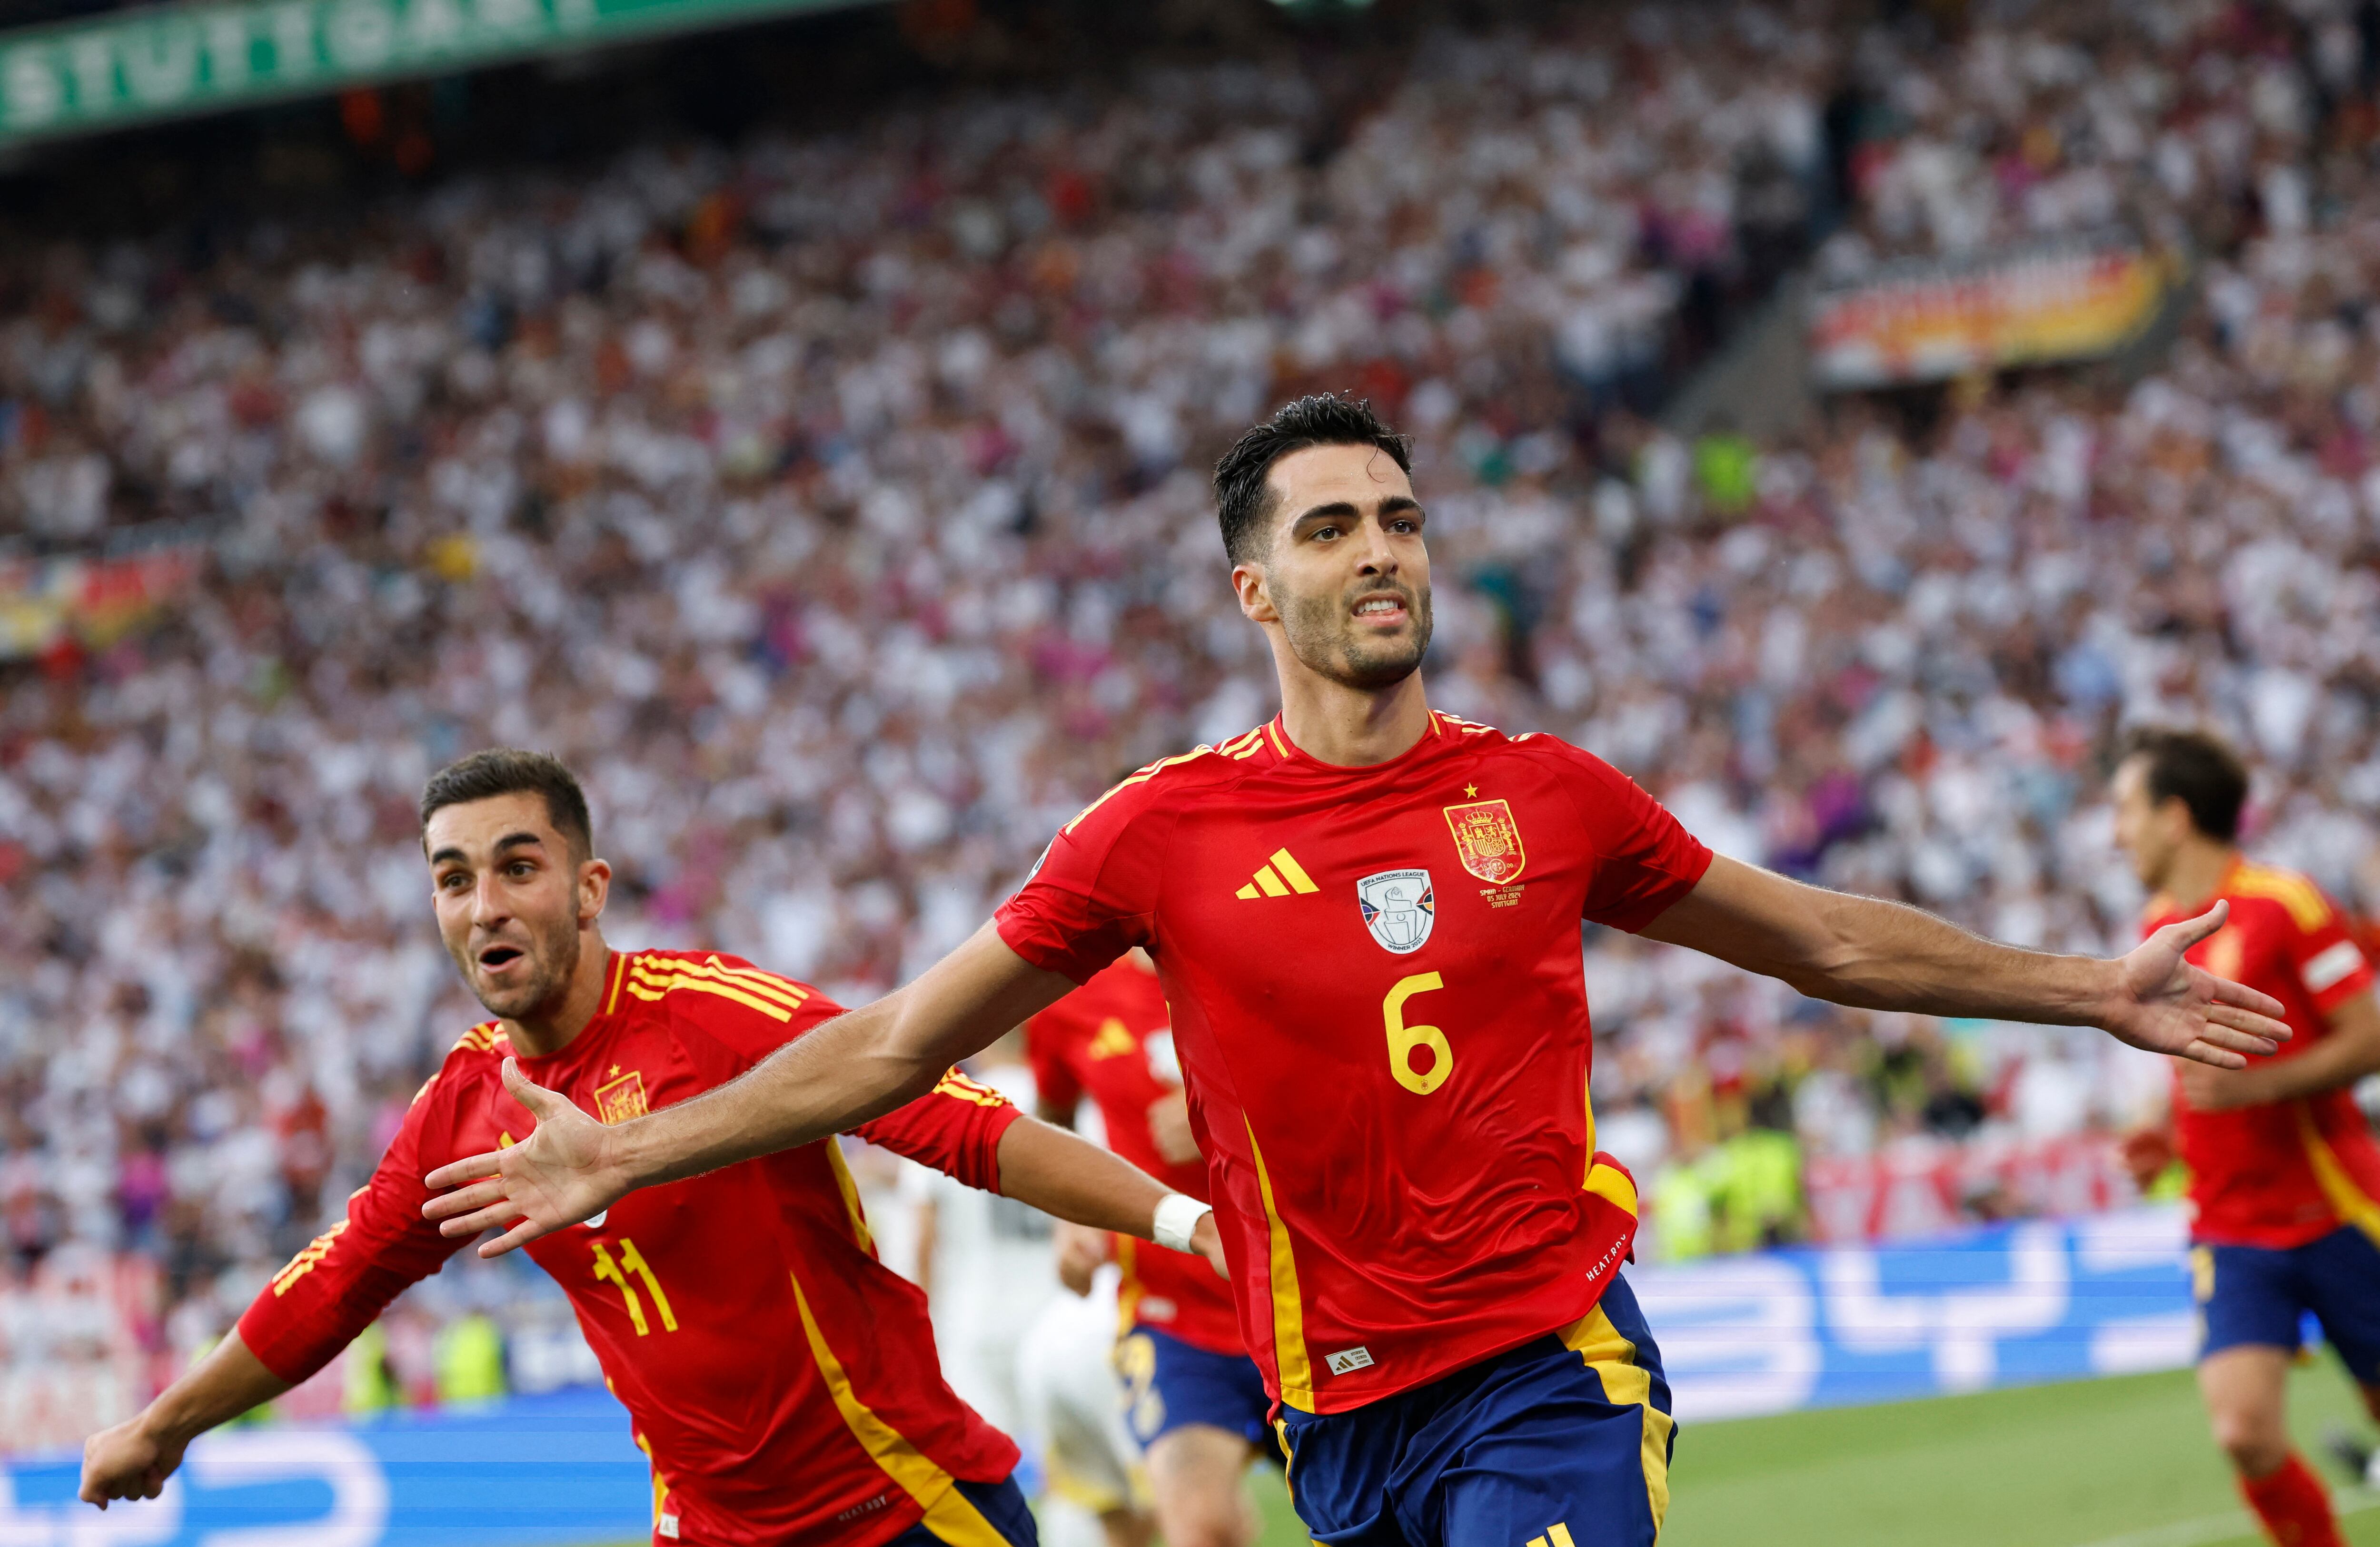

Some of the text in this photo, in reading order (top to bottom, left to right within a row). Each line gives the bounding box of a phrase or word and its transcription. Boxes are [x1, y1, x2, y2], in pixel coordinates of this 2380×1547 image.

[1376, 872, 1401, 881] NATIONS
[1502, 884, 1525, 893] GERMANY
[1491, 899, 1518, 908] STUTTGART
[1411, 937, 1423, 948] 2023
[1383, 970, 1454, 1095] 6
[591, 1237, 679, 1337] 11
